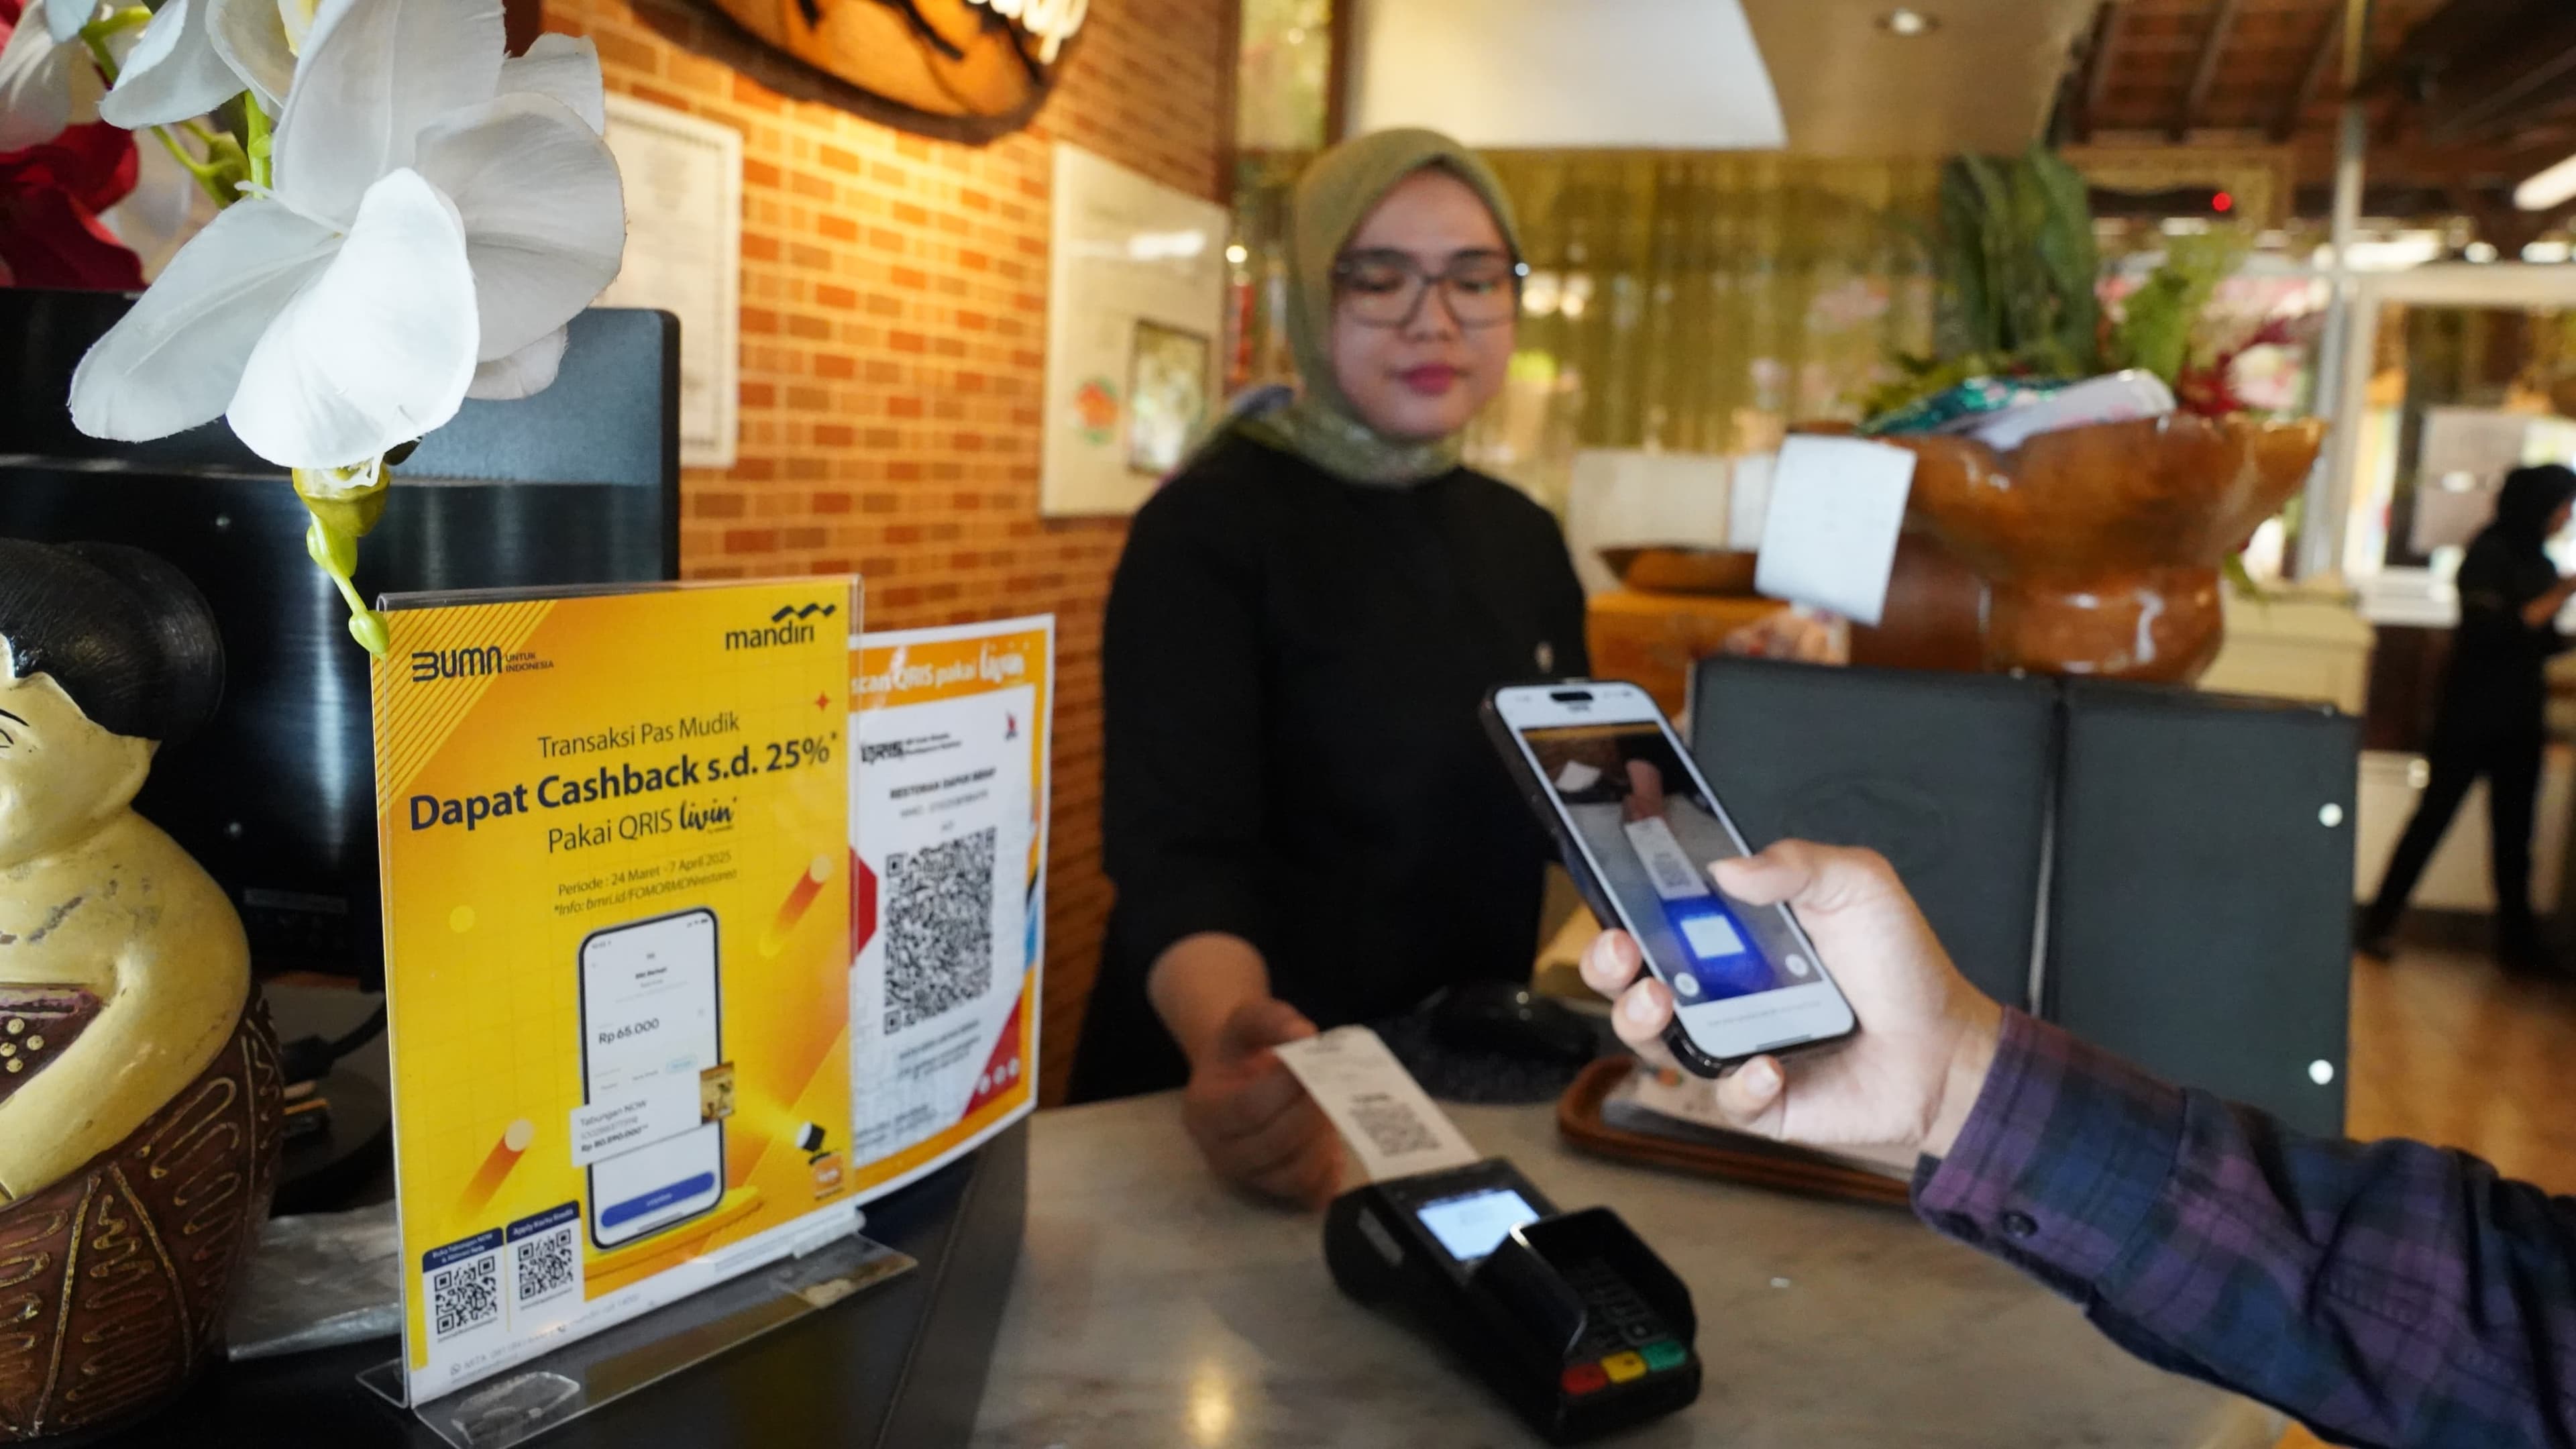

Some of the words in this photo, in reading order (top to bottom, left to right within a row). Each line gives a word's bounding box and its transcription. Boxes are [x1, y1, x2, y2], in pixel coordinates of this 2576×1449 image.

[726, 616, 814, 651] mandiri
[412, 645, 502, 682] BUMN
[505, 659, 554, 673] INDONESIA
[539, 729, 636, 759] Transaksi
[641, 722, 674, 745] Pas
[678, 711, 740, 738] Mudik
[410, 784, 529, 831] Dapat
[537, 754, 700, 808] Cashback
[707, 743, 759, 782] s.d.
[549, 819, 612, 853] Pakai
[618, 807, 673, 842] QRIS
[558, 878, 603, 896] Periode
[611, 874, 625, 886] 24
[627, 865, 661, 882] Maret
[678, 855, 704, 873] April
[704, 851, 732, 867] 2025
[598, 1032, 615, 1045] Rp
[617, 1018, 659, 1040] 65.000
